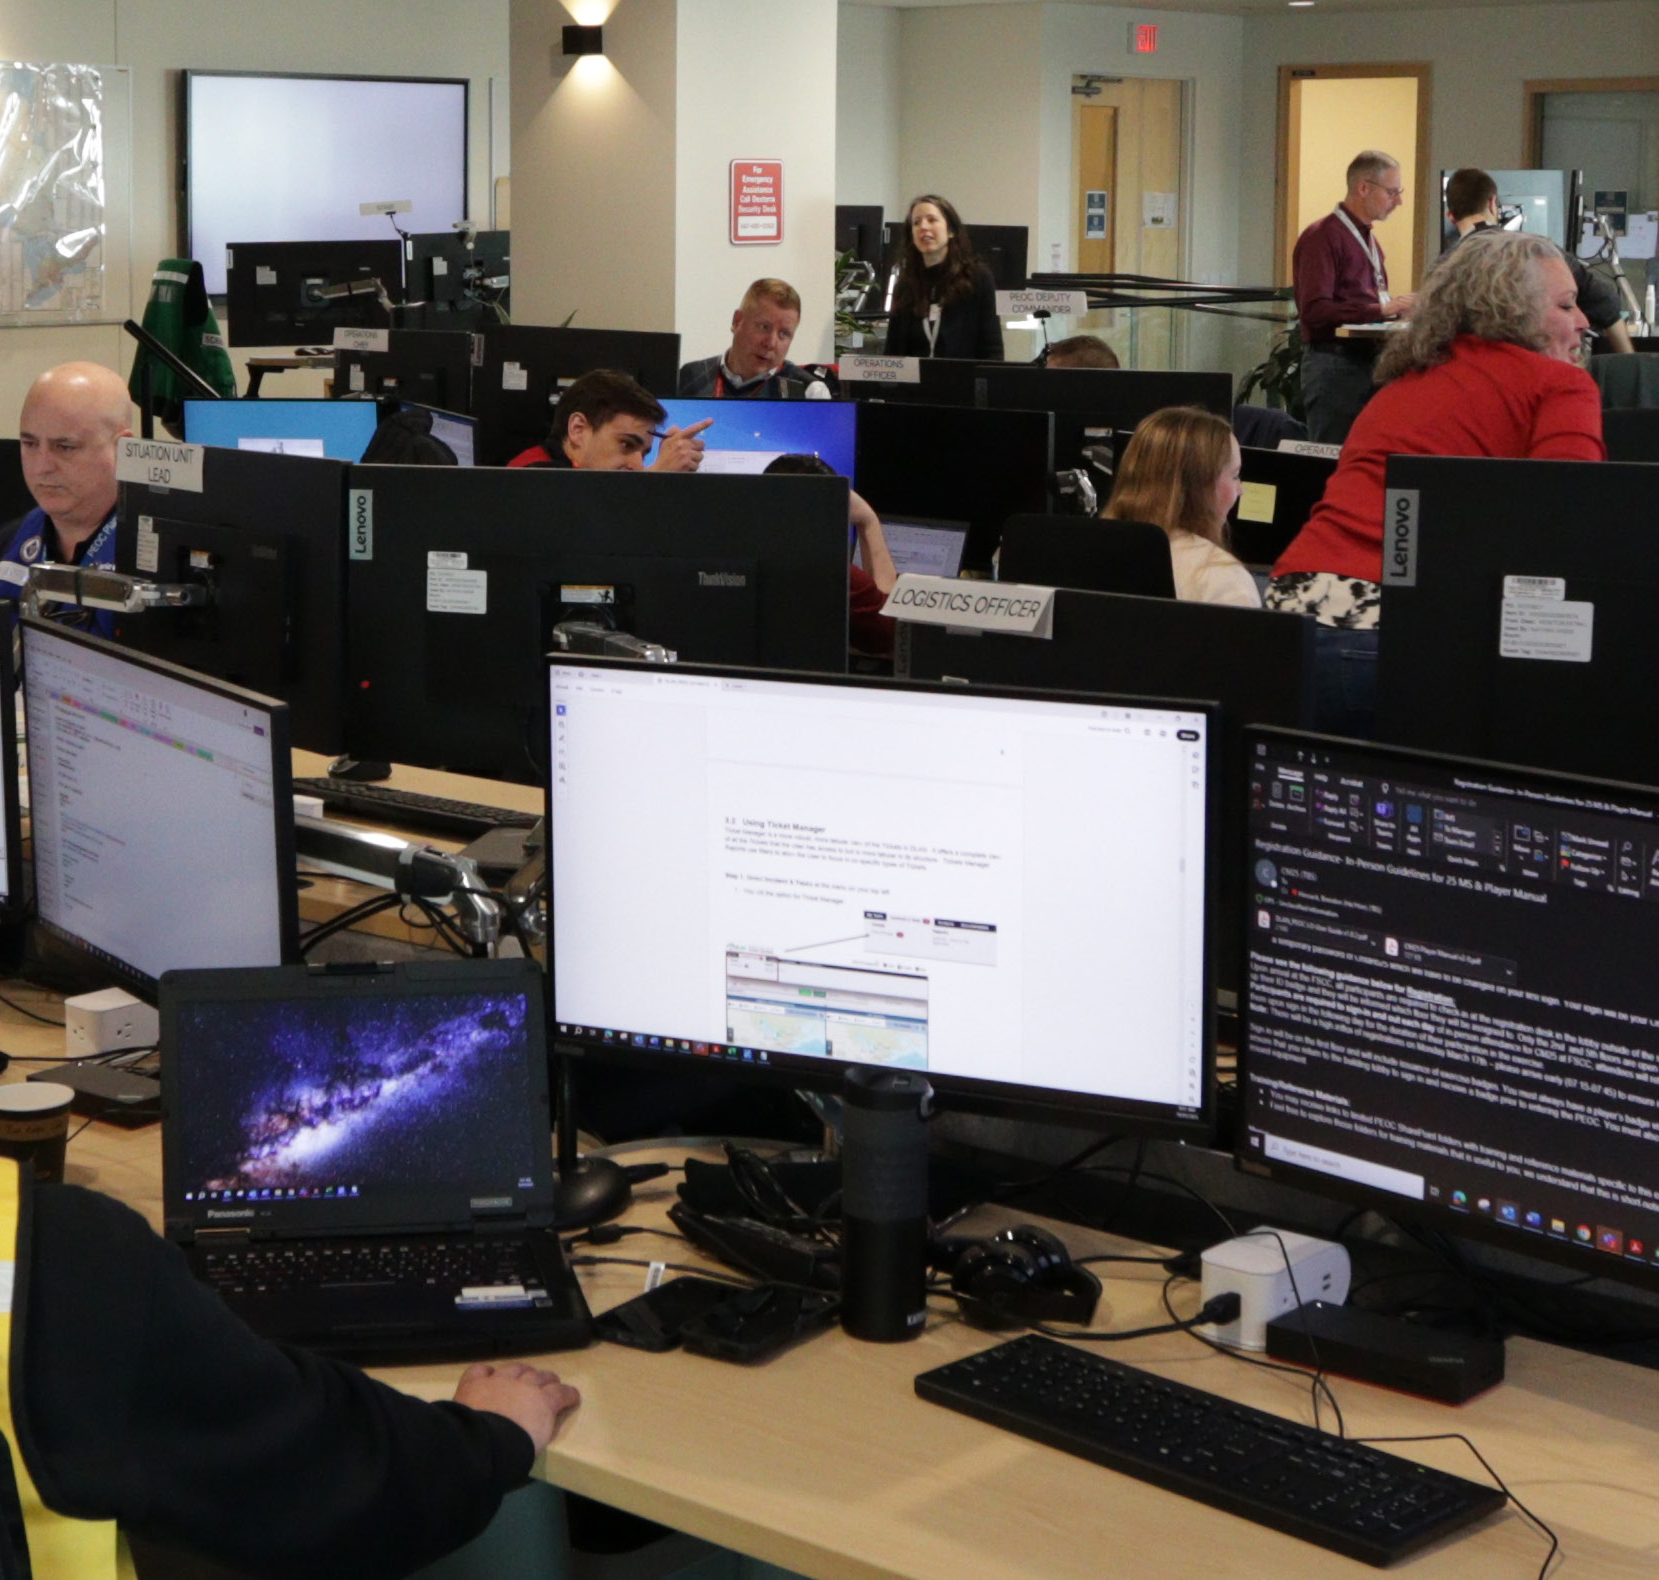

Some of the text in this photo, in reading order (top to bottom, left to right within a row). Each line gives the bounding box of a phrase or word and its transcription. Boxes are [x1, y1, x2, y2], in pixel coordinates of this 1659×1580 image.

[1137, 24, 1158, 52] EXIT
[752, 165, 763, 174] For
[741, 174, 774, 184] Emergency
[742, 186, 774, 194] Assistance
[1035, 292, 1071, 302] DEPUTY
[1012, 304, 1071, 314] COMMANDER
[853, 358, 904, 370] OPERATIONS
[862, 370, 897, 380] OFFICER
[125, 442, 194, 464] SITUATION UNIT
[1294, 443, 1340, 456] OPERATIO
[147, 467, 171, 484] LEAD
[354, 494, 367, 554] Lenovo
[1391, 497, 1410, 578] Lenovo
[697, 570, 746, 587] ThinkVision
[891, 587, 1042, 618] LOGISTICS OFFICER
[742, 817, 764, 828] Using
[767, 820, 790, 830] Ticket
[792, 822, 825, 834] Manager
[1255, 840, 1302, 856] Registration
[1345, 856, 1385, 872] In-Person
[1386, 863, 1430, 880] Guidelines
[1431, 872, 1444, 883] for
[1484, 882, 1511, 898] Player
[1512, 888, 1546, 903] Manual
[207, 1209, 255, 1219] Panasonic
